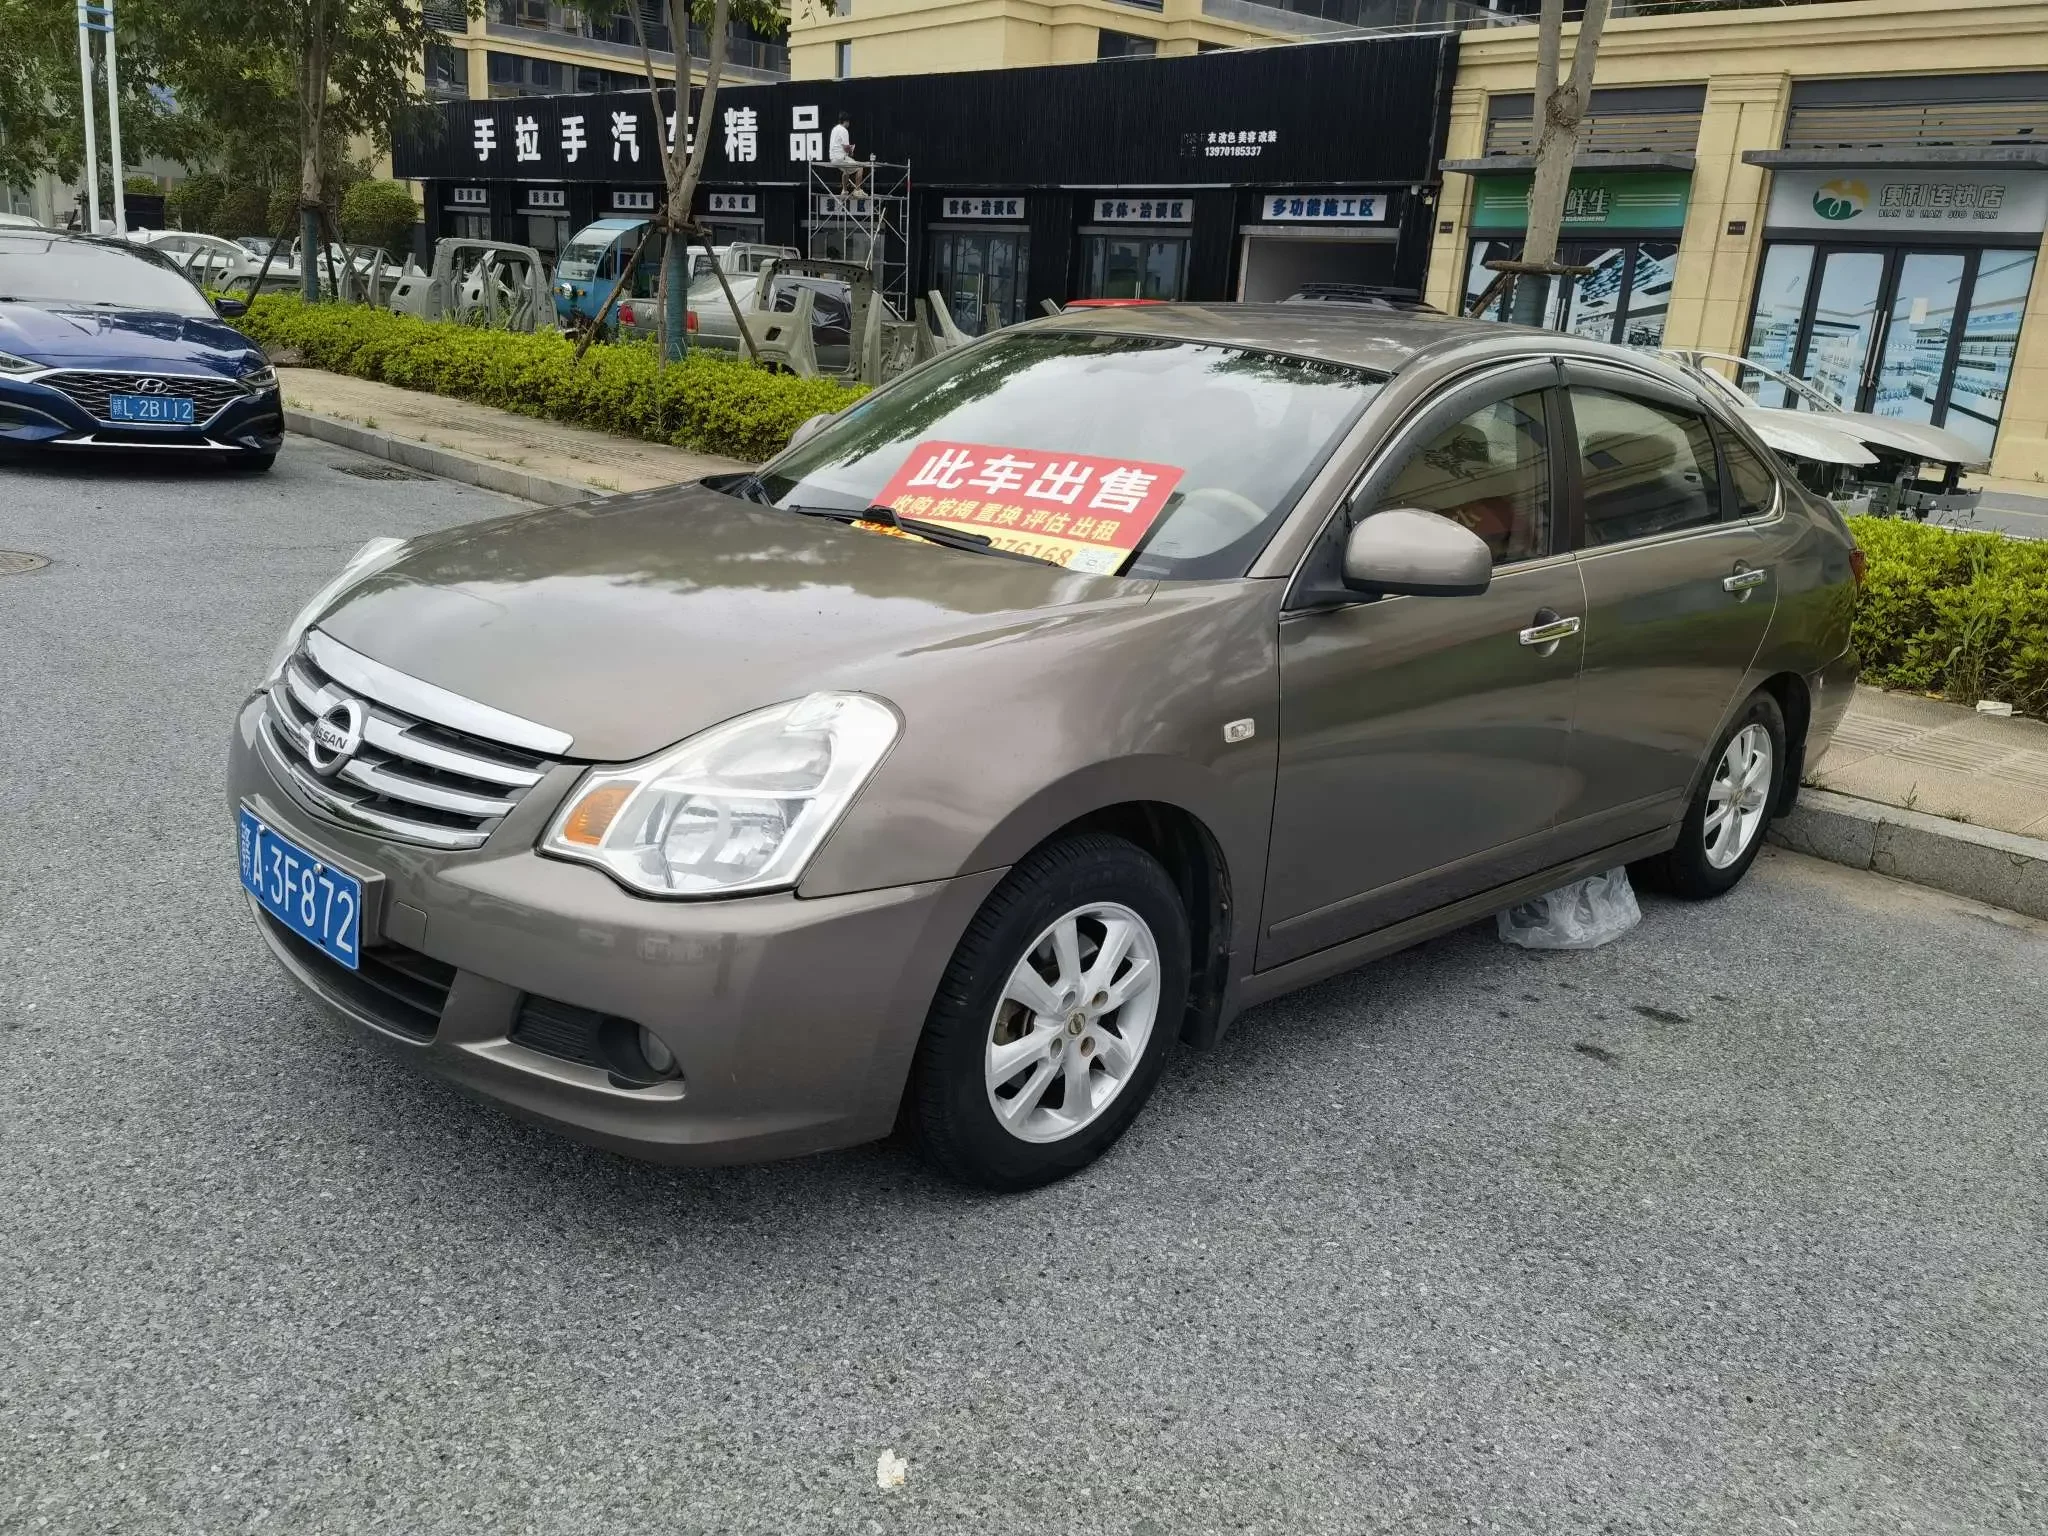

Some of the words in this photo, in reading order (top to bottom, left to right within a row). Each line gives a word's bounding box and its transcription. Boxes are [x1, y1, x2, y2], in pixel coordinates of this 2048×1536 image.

[474, 105, 823, 162] 手拉手汽车精品
[1205, 145, 1262, 156] 13970185337
[1272, 198, 1375, 217] 多功能施工区
[1879, 184, 2006, 209] 便利连锁店
[907, 448, 1158, 513] 此车出售
[928, 498, 974, 520] 按揭
[975, 503, 1024, 527] 置换
[1023, 508, 1071, 534] 评估
[1068, 517, 1120, 542] 出租
